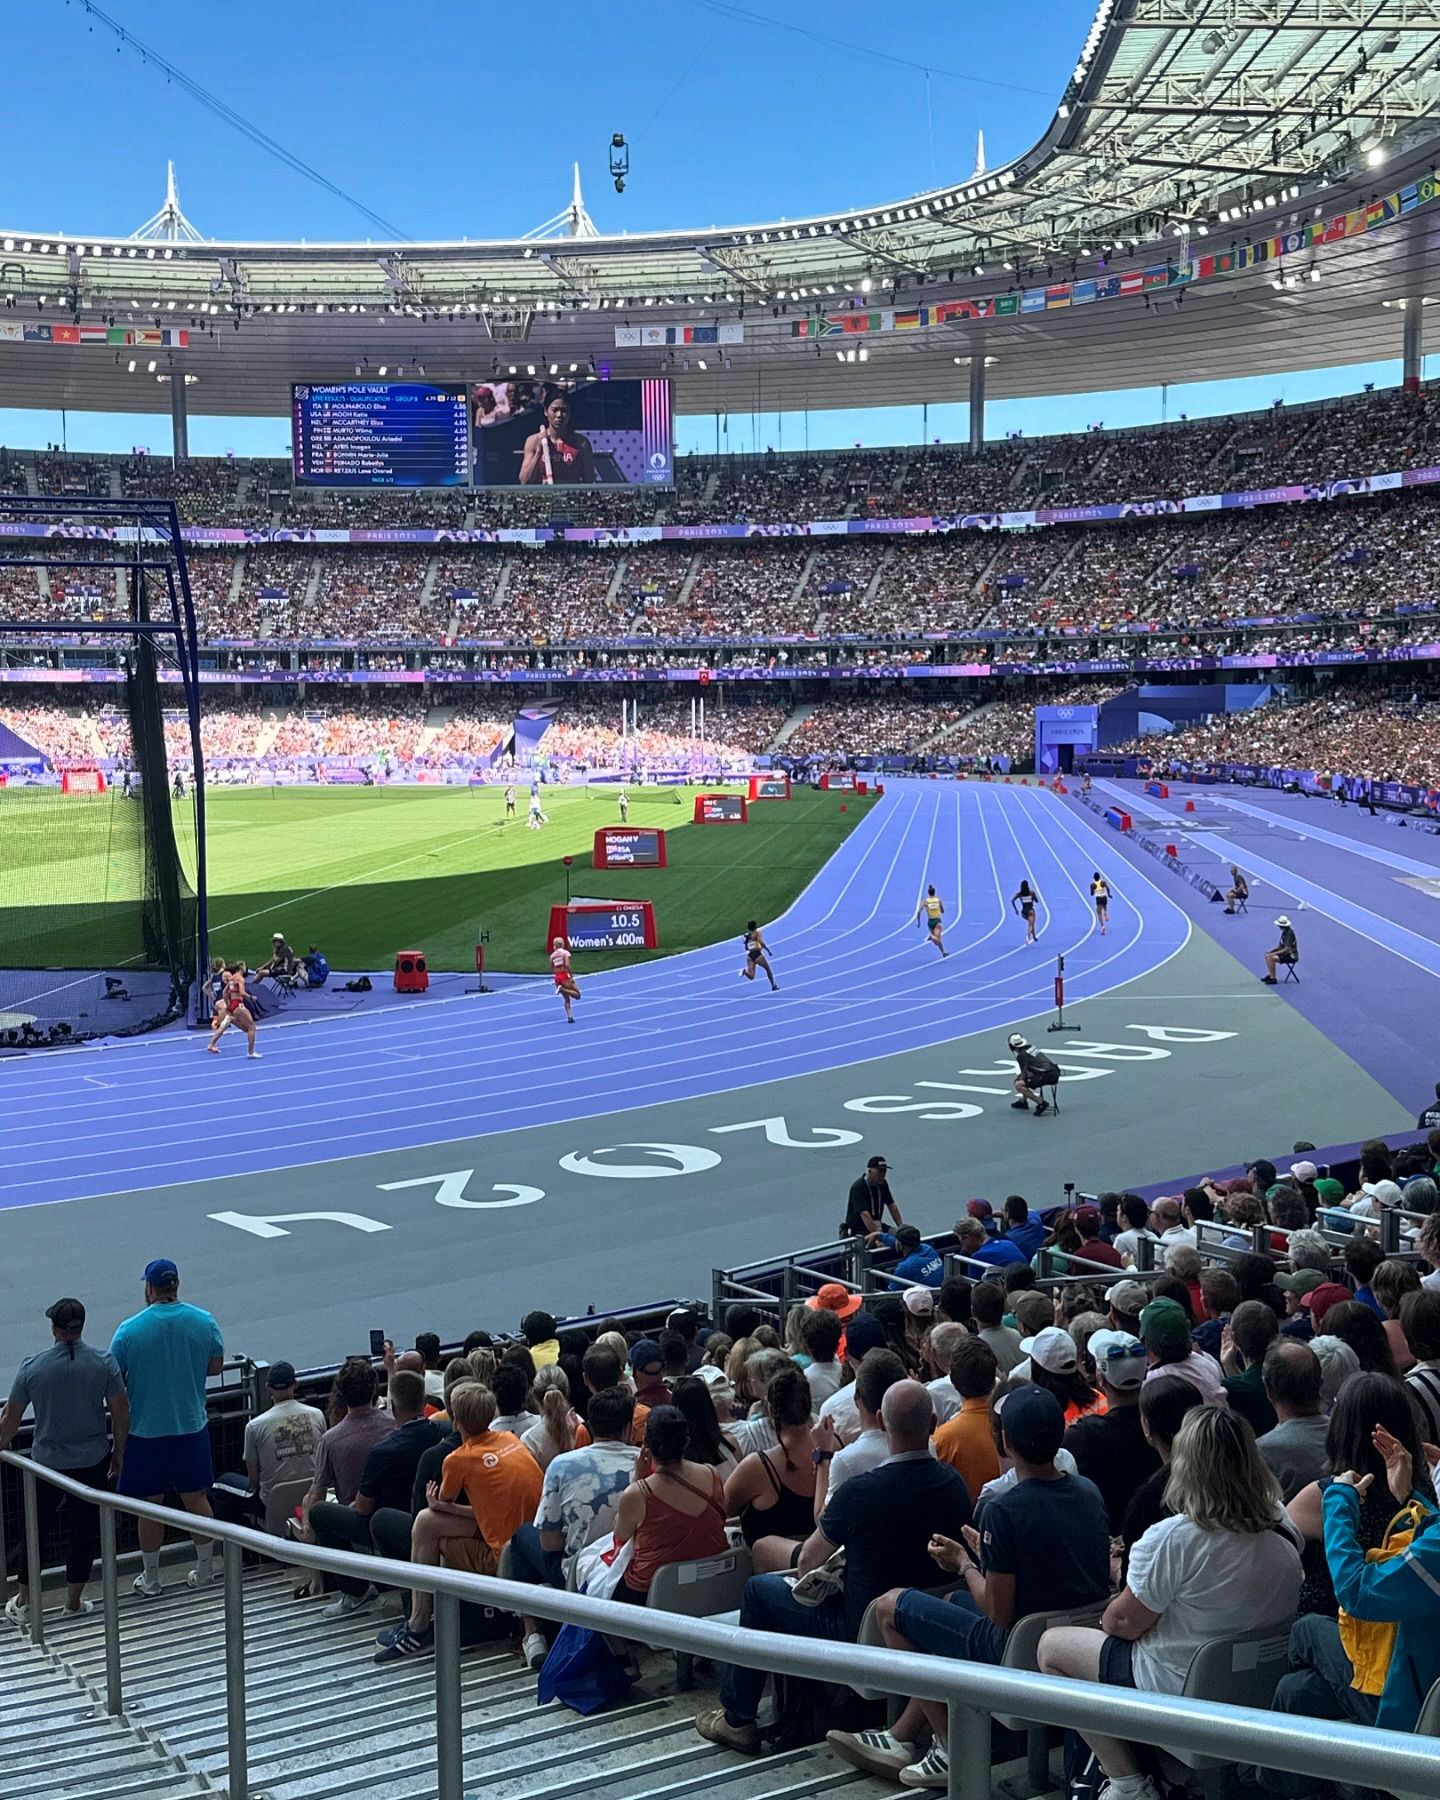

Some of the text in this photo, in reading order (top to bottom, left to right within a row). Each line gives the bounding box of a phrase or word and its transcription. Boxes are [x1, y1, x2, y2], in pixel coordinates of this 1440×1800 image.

[1238, 492, 1286, 502] PARIS 2024
[1080, 510, 1102, 518] 2024
[204, 530, 226, 538] 2024
[611, 914, 640, 928] 10.5
[568, 933, 644, 948] Women's 400m
[843, 1023, 1240, 1120] PARIS
